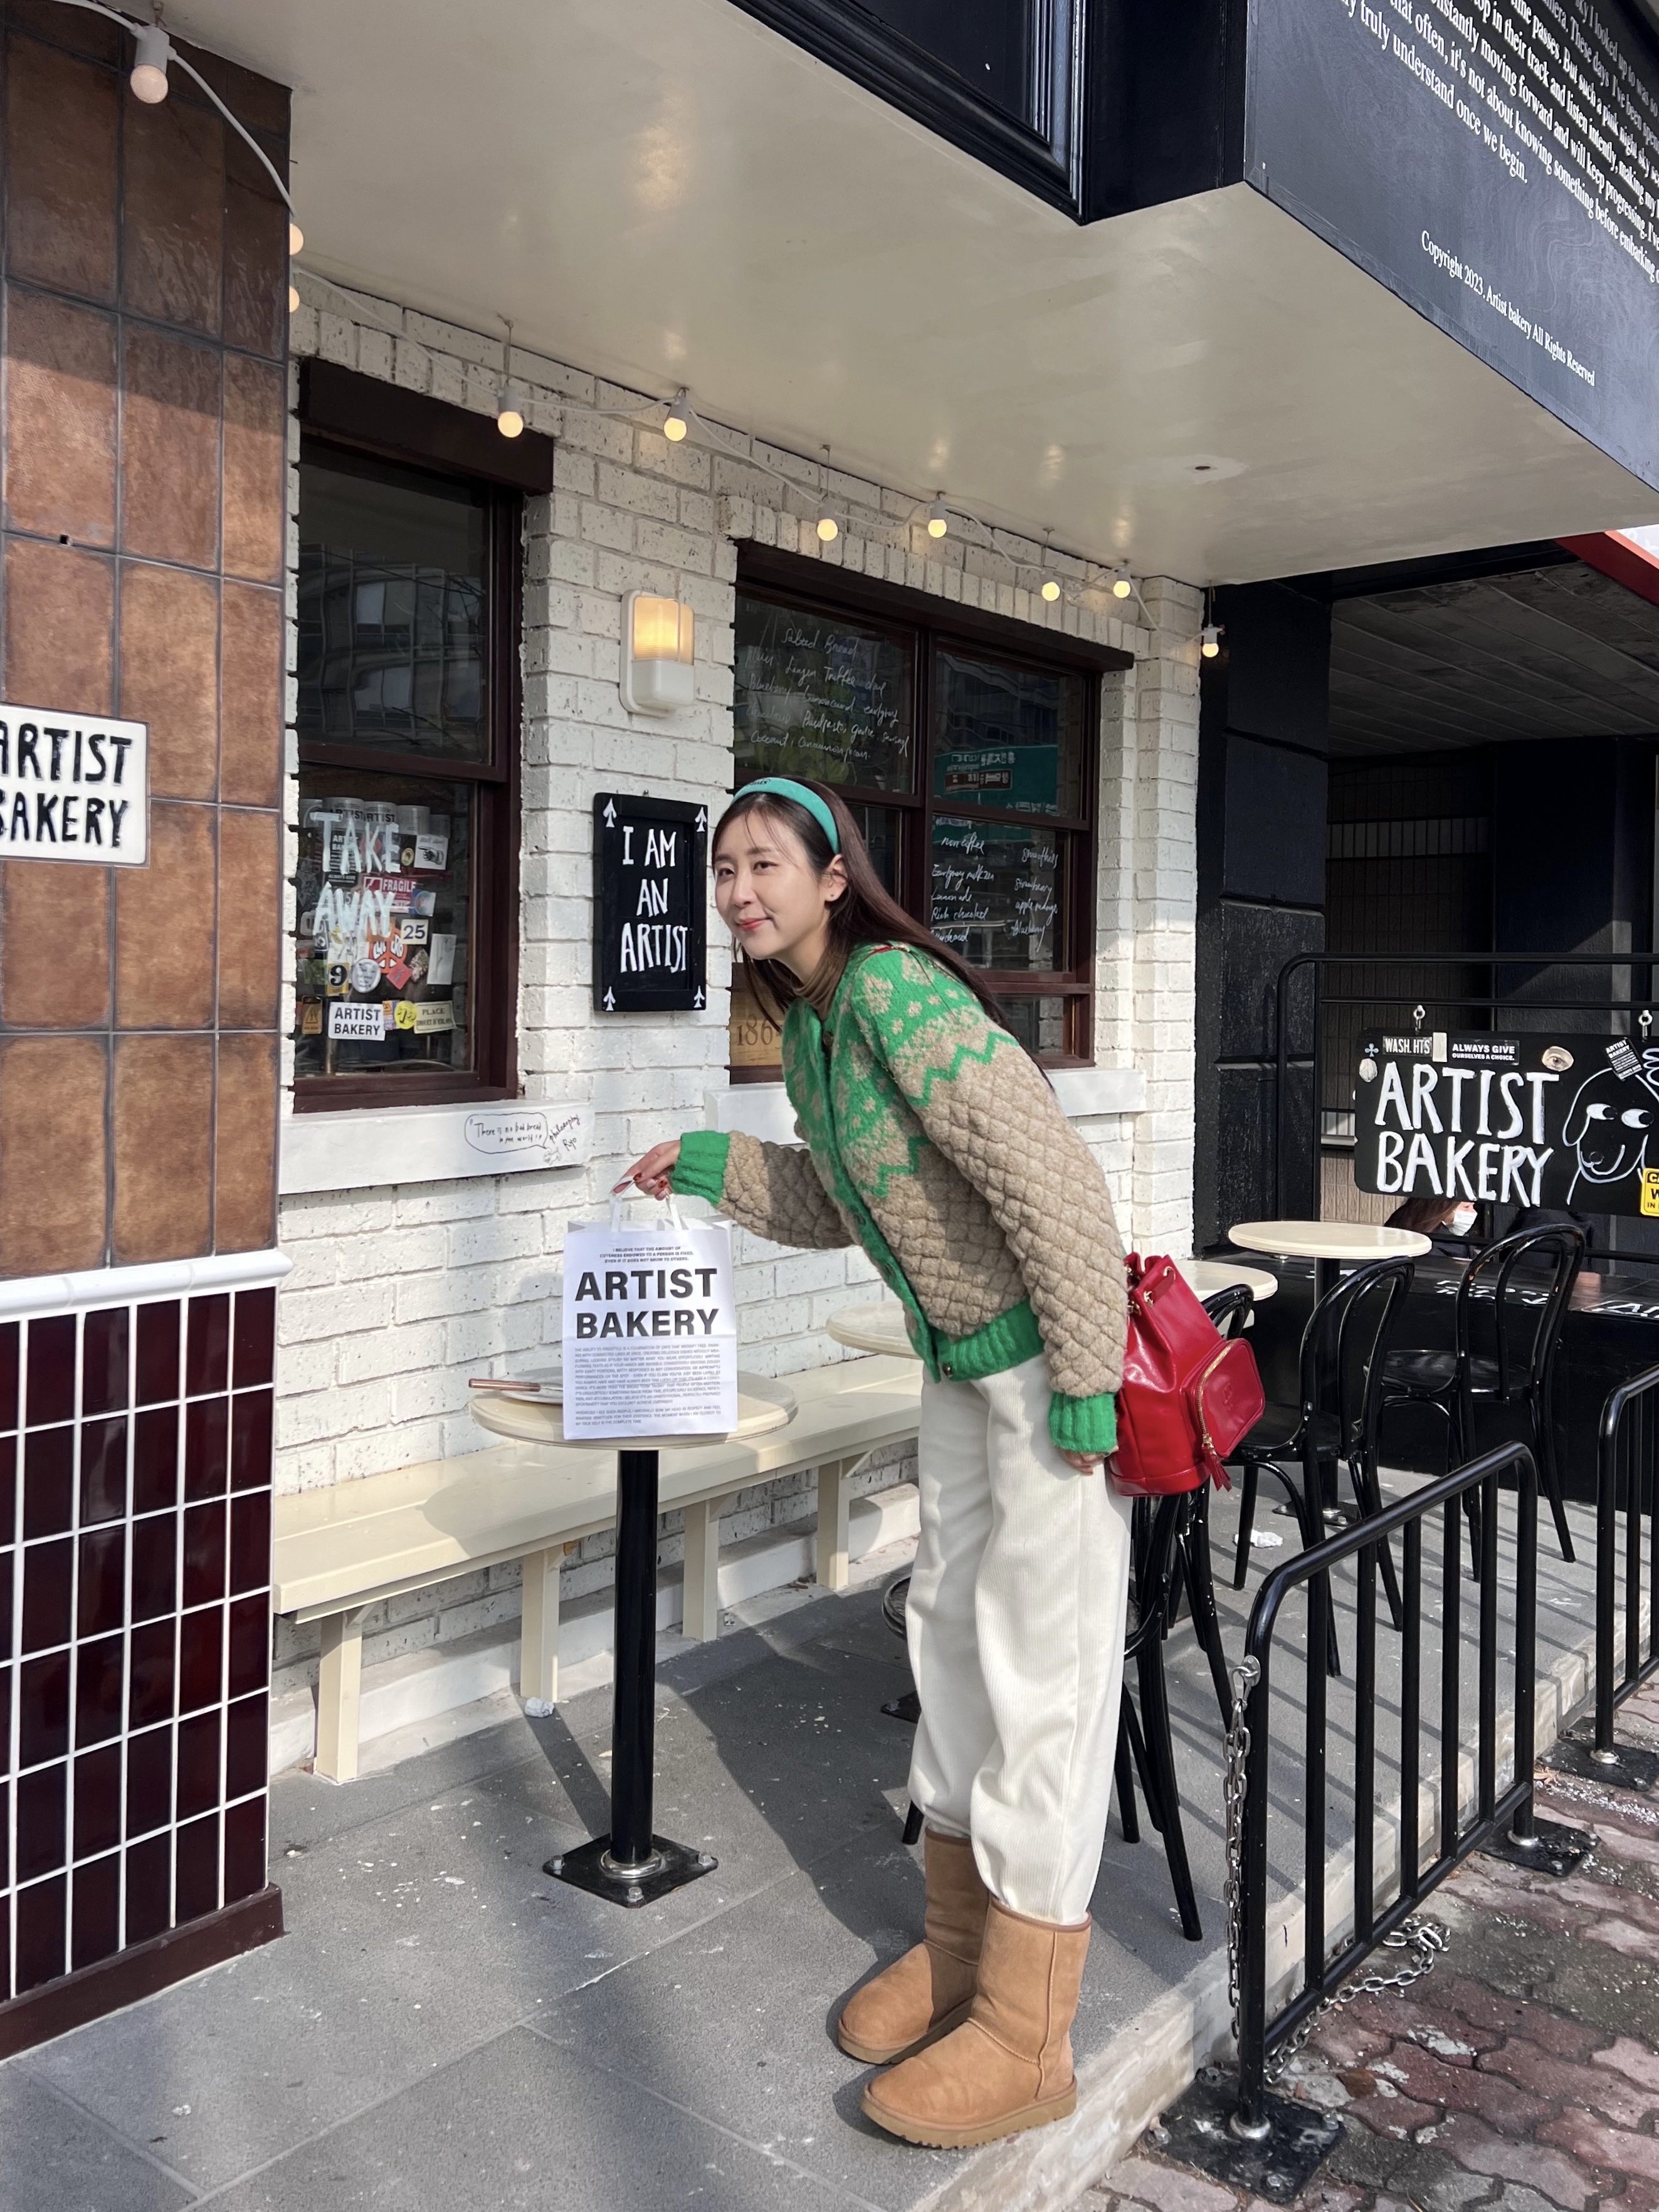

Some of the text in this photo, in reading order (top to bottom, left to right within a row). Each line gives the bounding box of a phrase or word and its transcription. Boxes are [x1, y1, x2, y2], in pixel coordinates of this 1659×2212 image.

[1594, 13, 1618, 61] looked
[1361, 0, 1528, 184] truly understand once we begin.
[1532, 15, 1562, 64] passes.
[1563, 46, 1577, 83] But
[1579, 74, 1596, 107] such
[1596, 98, 1602, 114] a
[1602, 104, 1619, 136] pink
[1620, 126, 1638, 159] night
[1638, 147, 1650, 177] sky
[1570, 16, 1592, 63] These
[1593, 51, 1609, 87] days
[1626, 94, 1641, 130] been
[1492, 1, 1502, 33] in
[1505, 19, 1527, 60] their
[1527, 47, 1549, 87] track
[1551, 78, 1566, 107] and
[1567, 90, 1588, 134] listen
[1588, 118, 1618, 174] intently,
[1619, 161, 1644, 206] making
[1645, 191, 1656, 217] my
[1415, 13, 1448, 65] often,
[1451, 41, 1467, 78] it's
[1468, 68, 1485, 98] not
[1487, 86, 1514, 129] about
[1515, 110, 1552, 175] knowing
[1554, 160, 1594, 219] something
[1595, 198, 1619, 240] before
[1620, 231, 1655, 283] embarking
[1480, 38, 1517, 97] moving
[1519, 75, 1553, 130] forward
[1554, 121, 1569, 149] and
[1571, 139, 1586, 169] will
[1586, 152, 1604, 194] keep
[1606, 180, 1648, 240] progressing.
[1421, 230, 1463, 280] Copyright
[1486, 285, 1507, 317] Artist
[1509, 302, 1532, 339] bakery
[1532, 324, 1544, 346] All
[1545, 332, 1566, 364] Rights
[1567, 350, 1595, 386] Reserved
[310, 811, 401, 875] TAKE
[622, 826, 677, 868] I AM
[312, 880, 397, 939] AWAY
[636, 878, 668, 917] AN
[404, 925, 426, 939] 25
[620, 922, 688, 974] ARTIST
[334, 1007, 381, 1021] ARTIST
[334, 1023, 380, 1036] BAKERY
[422, 1008, 446, 1016] PLACE
[1385, 1038, 1431, 1055] WASH. HTS
[1452, 1043, 1515, 1054] ALWAYS GIVE
[527, 1121, 542, 1131] bread
[1374, 1061, 1560, 1145] ARTIST
[562, 1137, 577, 1152] Ryo
[1376, 1132, 1555, 1208] BAKERY
[574, 1268, 718, 1302] ARTIST
[576, 1308, 720, 1339] BAKERY
